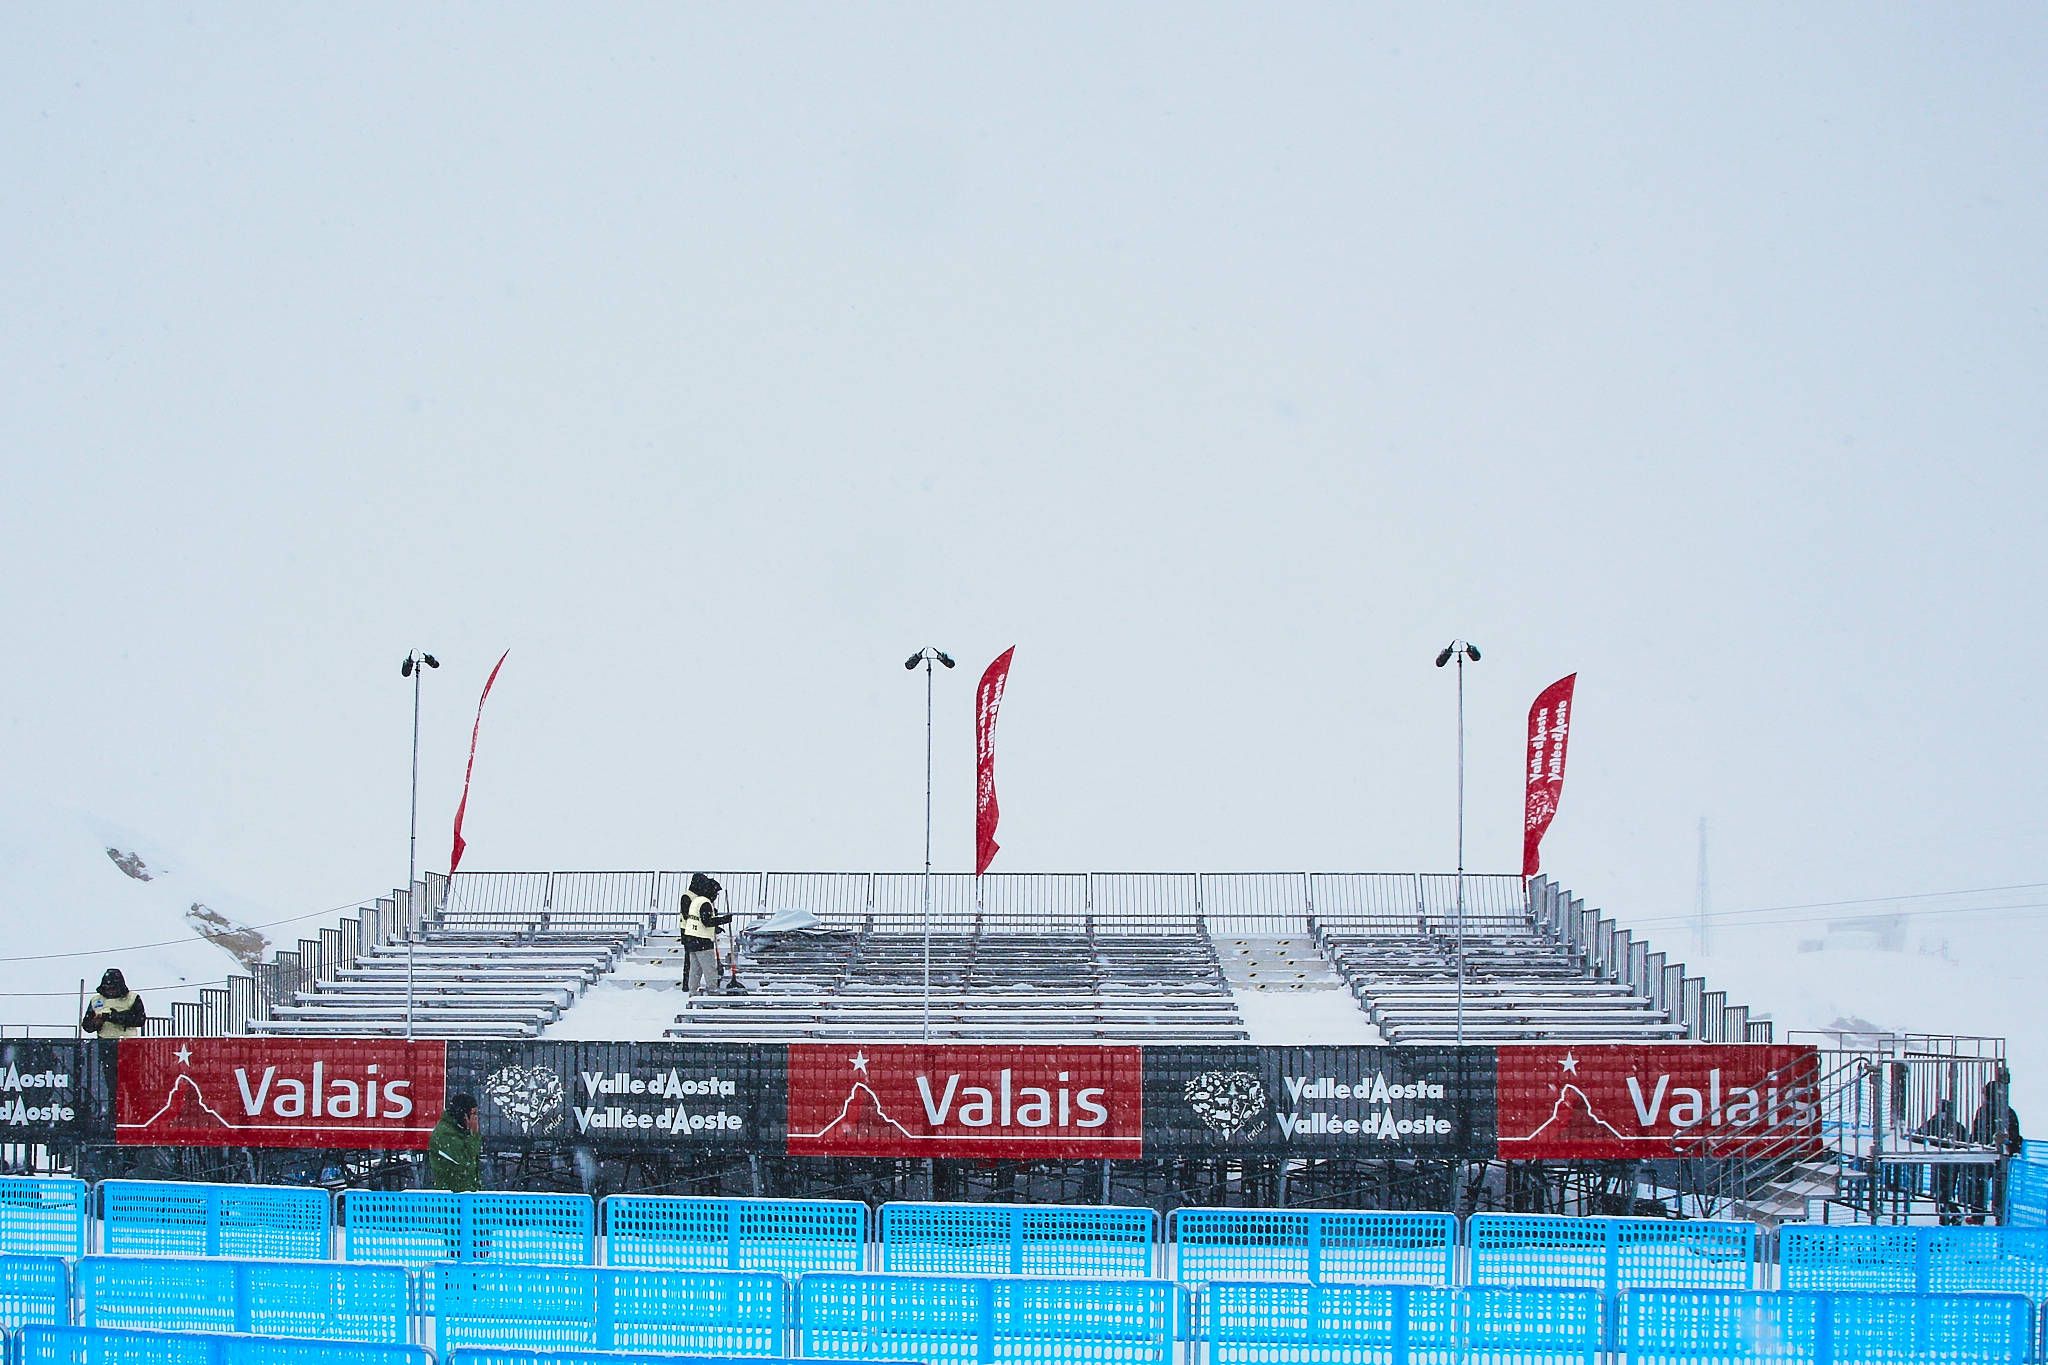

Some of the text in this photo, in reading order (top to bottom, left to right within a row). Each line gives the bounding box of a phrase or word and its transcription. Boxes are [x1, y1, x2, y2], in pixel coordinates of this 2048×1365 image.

[1529, 750, 1545, 785] Valle
[234, 1061, 413, 1118] Valais
[581, 1066, 736, 1100] Valle d'Aosta
[916, 1068, 1109, 1127] Valais
[1283, 1071, 1444, 1105] Valle d'Aosta
[1626, 1068, 1816, 1127] Valais
[573, 1102, 743, 1135] Vallée d'Aoste
[1276, 1107, 1452, 1141] Vallée d'Aoste
